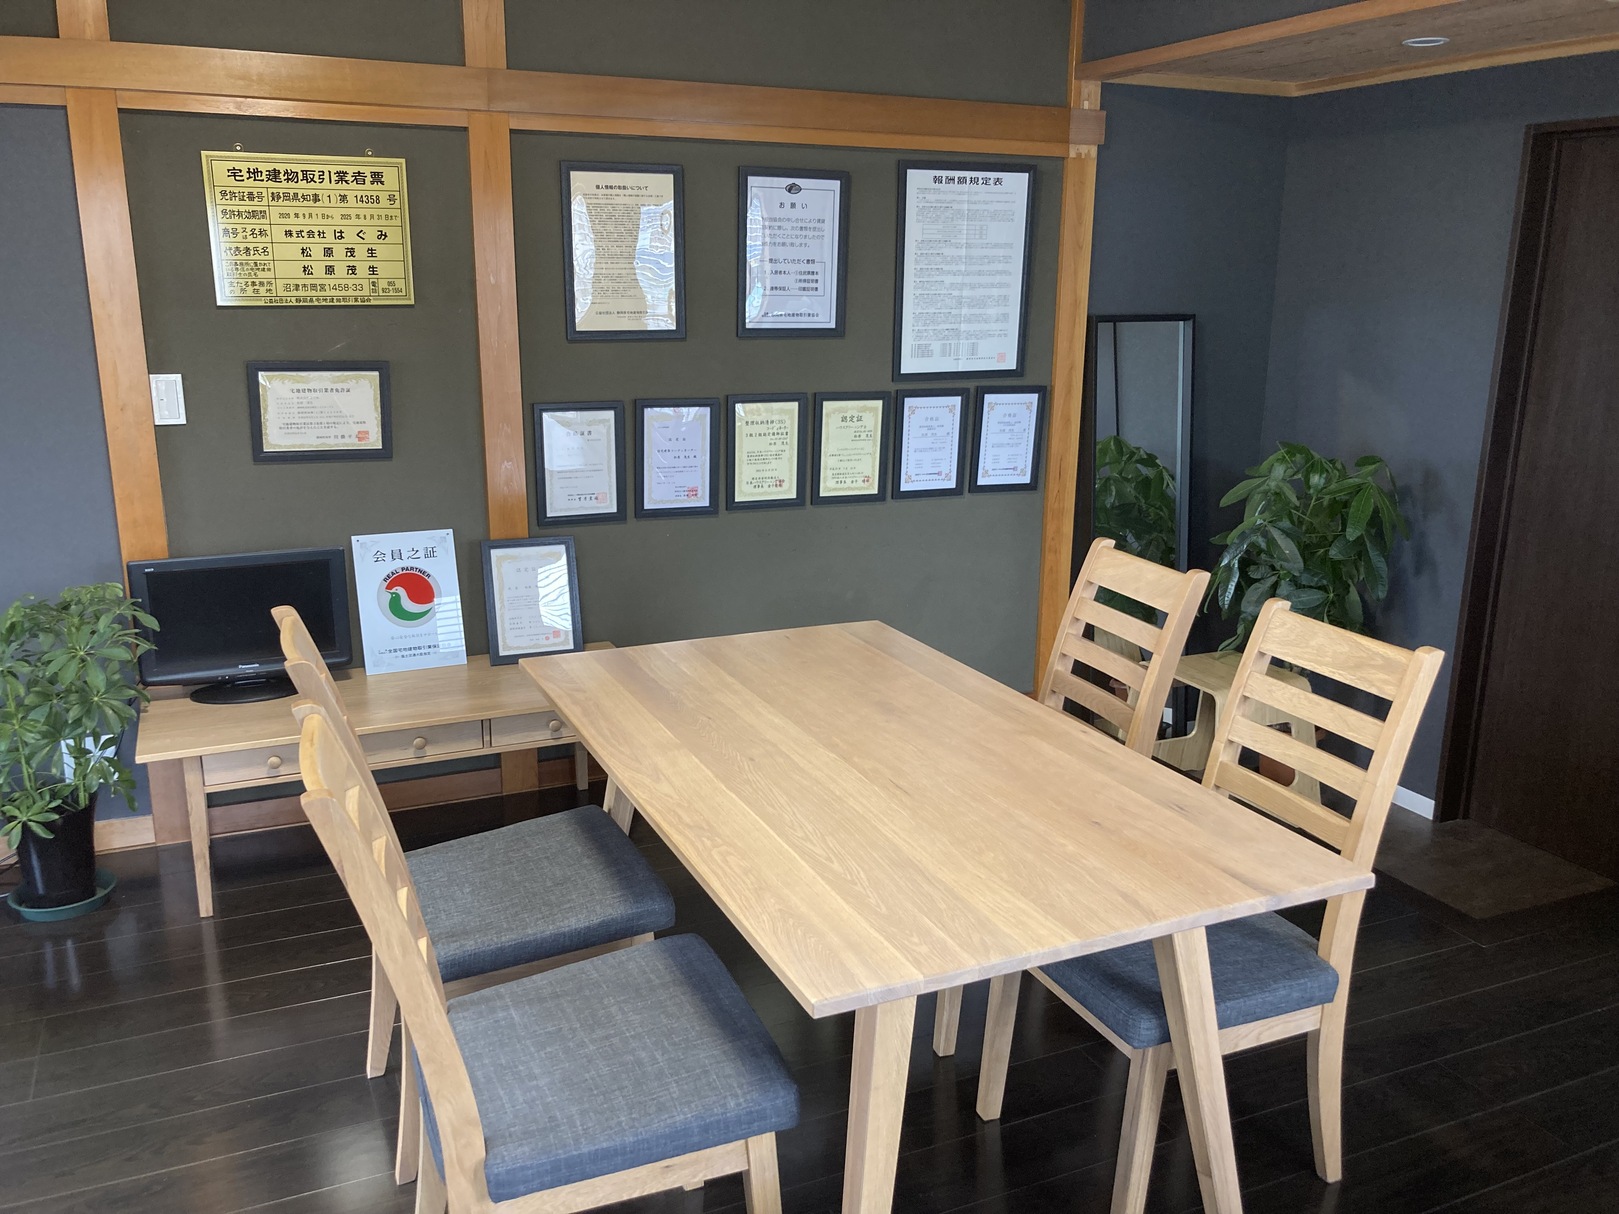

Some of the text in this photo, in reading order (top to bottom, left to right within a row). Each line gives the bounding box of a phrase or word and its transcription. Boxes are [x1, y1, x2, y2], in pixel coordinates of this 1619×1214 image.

[226, 166, 386, 186] 宅地建物取引業者票
[932, 175, 1004, 187] 報酬額規定表
[219, 190, 266, 203] 免許証番号
[354, 193, 381, 205] 14358
[387, 193, 398, 206] 号
[778, 201, 808, 210] お願い
[221, 208, 268, 220] 免許有効期間
[284, 229, 327, 239] 株式会社
[334, 229, 389, 241] はぐみ
[223, 245, 378, 258] 代表者氏名 松原茂生
[302, 264, 379, 276] 松原茂生
[282, 282, 364, 293] 沼津市岡宮1458-33
[840, 414, 864, 423] 認定証
[372, 545, 438, 563] 会員之証
[382, 566, 431, 583] REAL PARTNER
